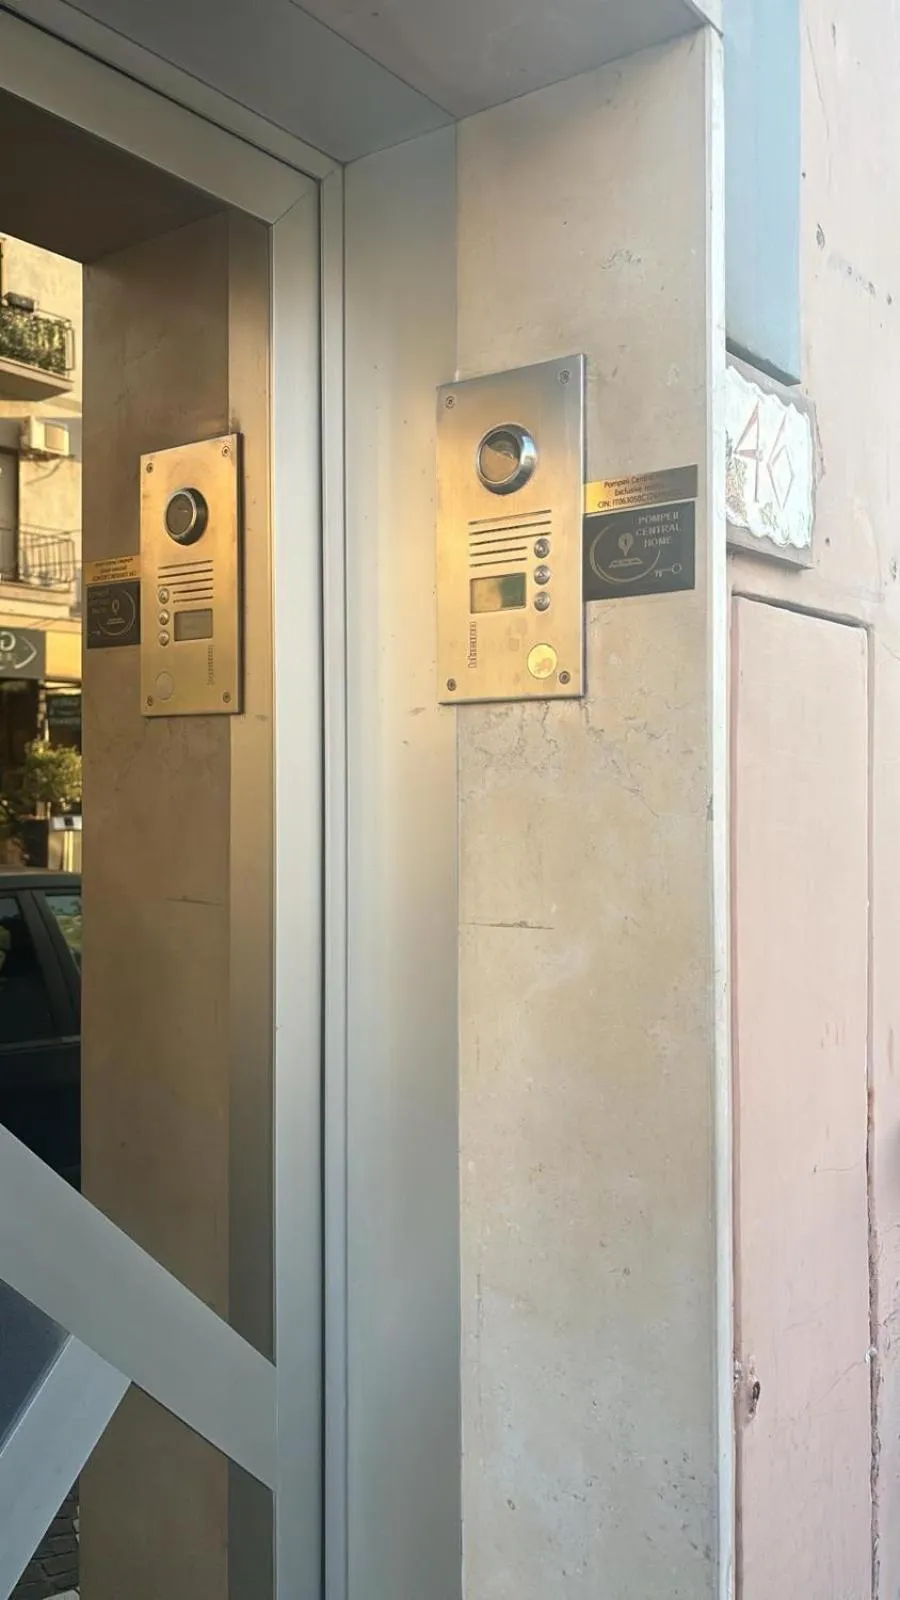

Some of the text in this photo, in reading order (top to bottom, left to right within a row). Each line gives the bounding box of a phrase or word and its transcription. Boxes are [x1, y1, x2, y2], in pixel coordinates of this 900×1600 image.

[604, 478, 629, 489] Pompeii
[614, 485, 642, 497] Exclusive
[635, 523, 683, 536] CENTRAL
[643, 536, 672, 549] HOME
